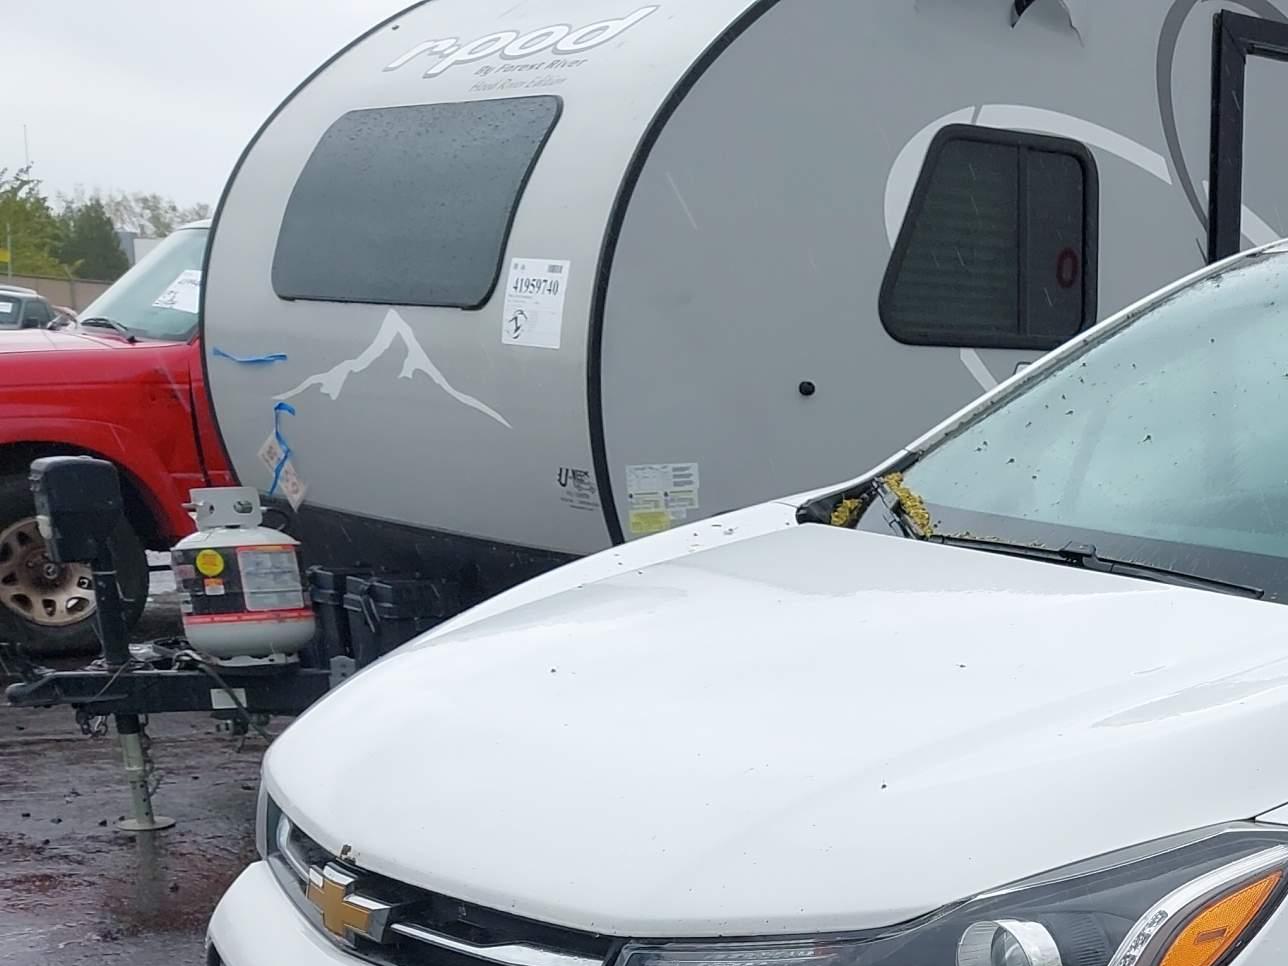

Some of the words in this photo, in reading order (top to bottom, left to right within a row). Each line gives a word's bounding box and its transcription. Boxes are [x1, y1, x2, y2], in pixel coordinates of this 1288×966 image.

[495, 62, 545, 73] Forest
[544, 59, 588, 70] River
[512, 278, 559, 296] 41959740
